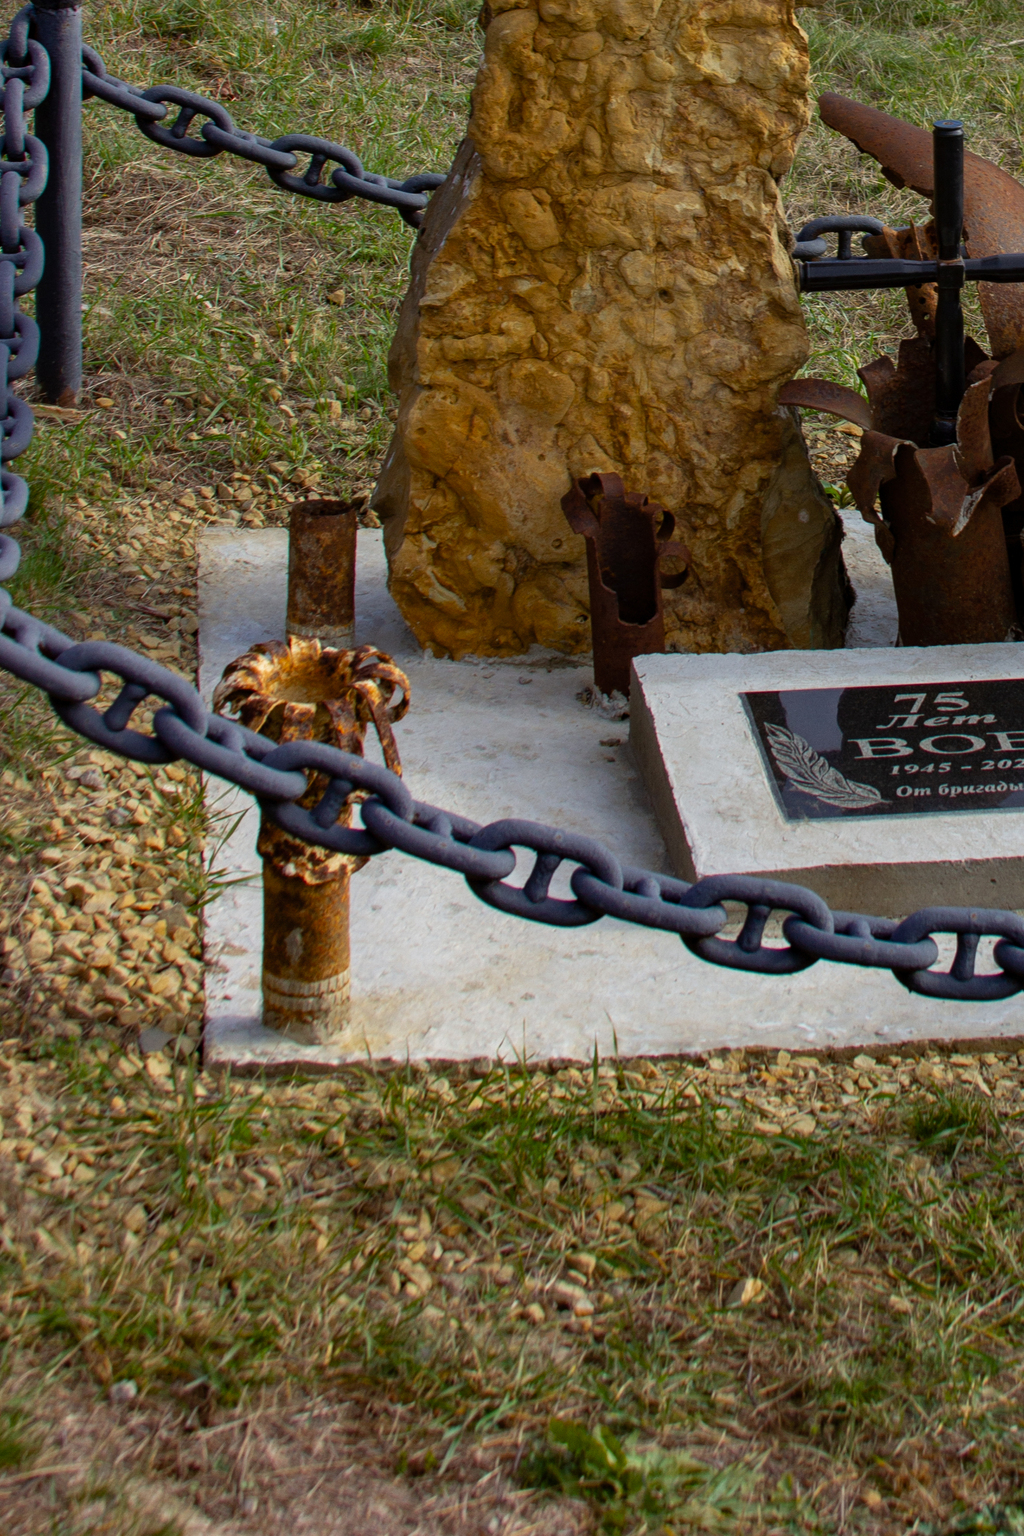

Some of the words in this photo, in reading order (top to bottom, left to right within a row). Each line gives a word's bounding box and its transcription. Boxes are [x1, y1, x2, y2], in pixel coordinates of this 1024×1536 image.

[893, 691, 970, 714] 75
[876, 713, 998, 731] Лет
[890, 761, 952, 776] 1945
[896, 784, 932, 798] От
[937, 779, 1024, 799] бригады
